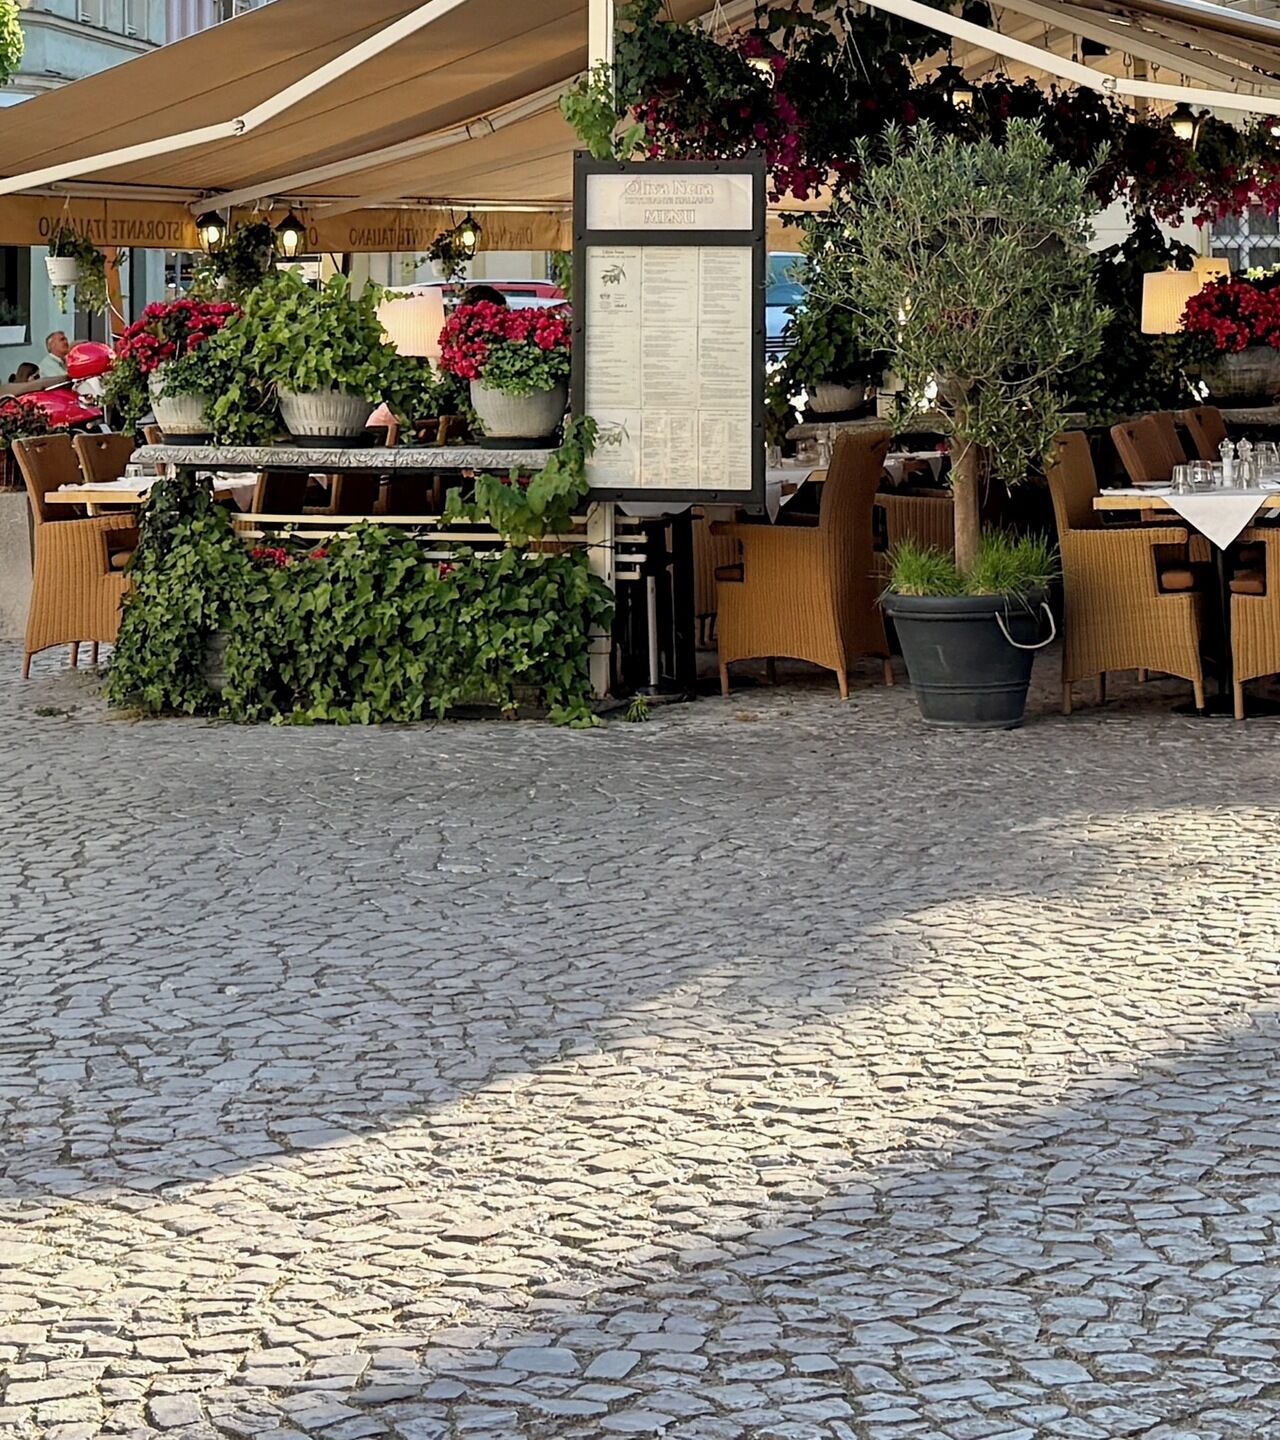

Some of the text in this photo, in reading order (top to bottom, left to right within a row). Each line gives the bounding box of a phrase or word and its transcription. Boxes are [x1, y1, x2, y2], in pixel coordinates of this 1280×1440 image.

[625, 178, 714, 196] Oliva Nera
[644, 209, 696, 225] MENU
